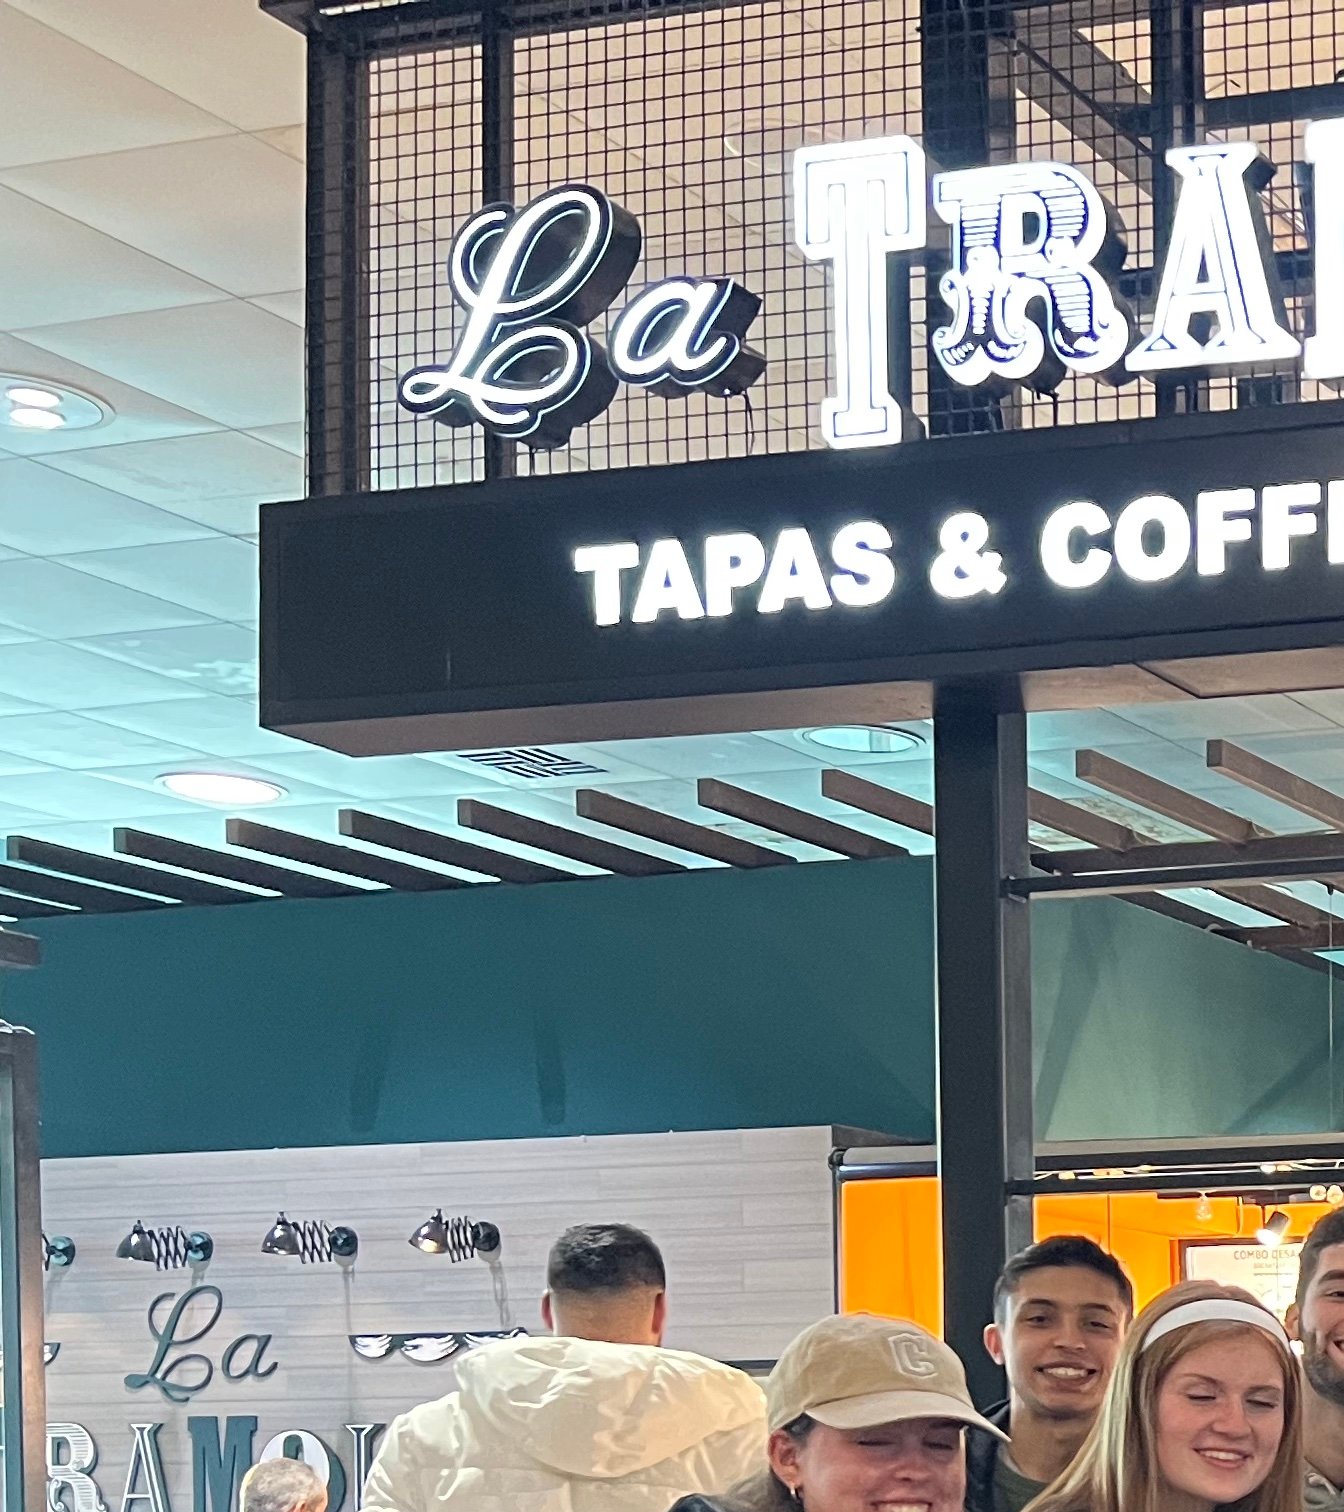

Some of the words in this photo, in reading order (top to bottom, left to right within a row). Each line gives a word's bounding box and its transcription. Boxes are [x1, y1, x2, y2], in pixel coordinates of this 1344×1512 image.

[399, 184, 757, 443] La
[573, 518, 897, 627] TAPAS
[929, 510, 1008, 599] &
[123, 1284, 279, 1404] La
